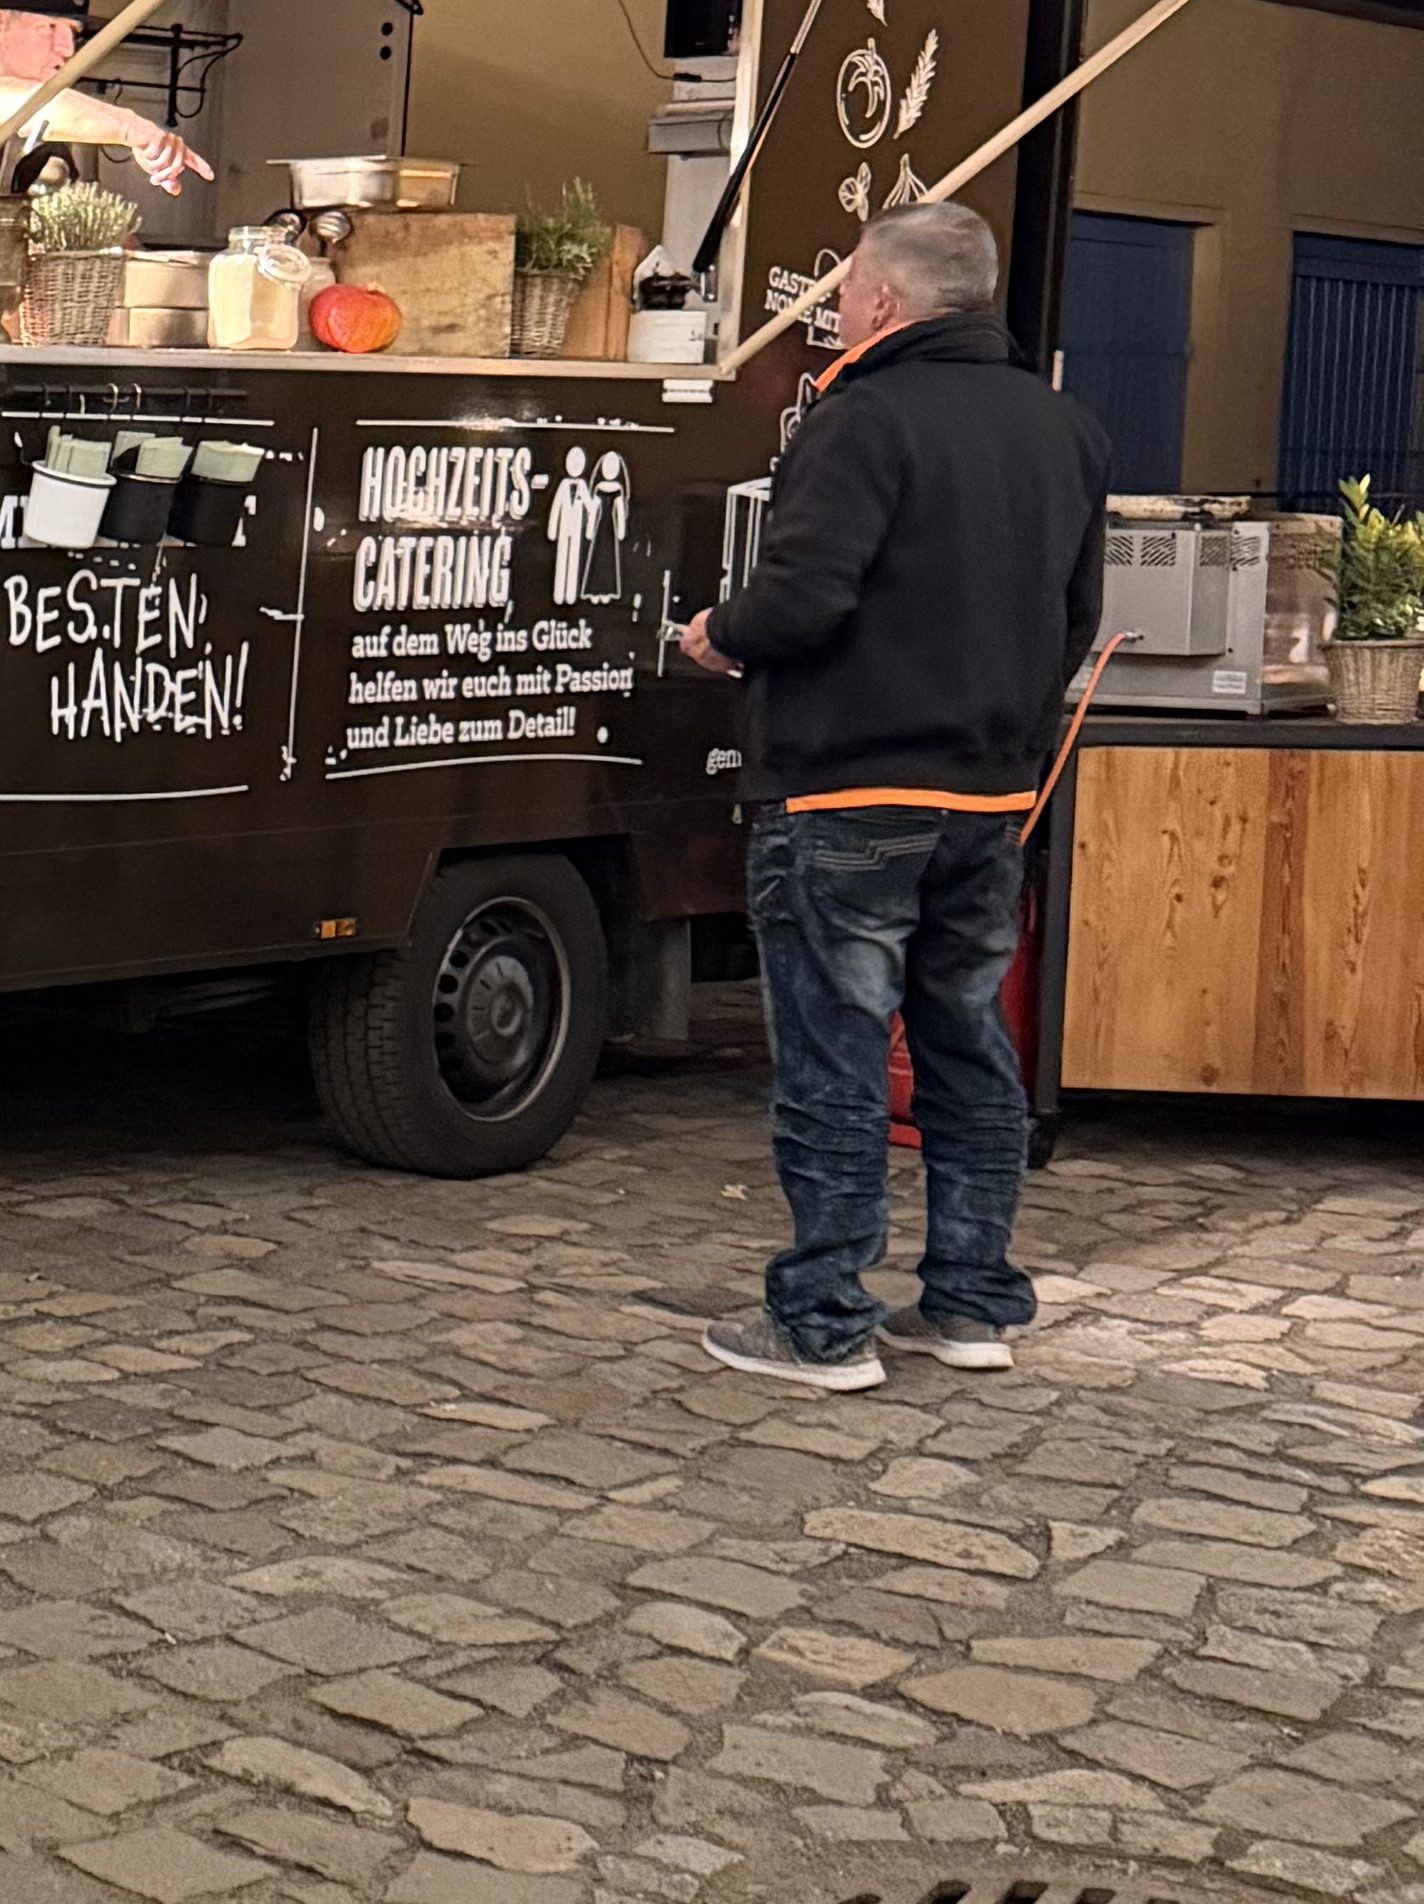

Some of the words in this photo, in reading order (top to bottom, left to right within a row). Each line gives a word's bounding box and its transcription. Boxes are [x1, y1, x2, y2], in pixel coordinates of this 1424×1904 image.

[359, 446, 550, 523] HOCHZEITS-
[353, 536, 513, 612] CATERING
[4, 569, 196, 658] BESTEN
[351, 625, 391, 658] auf
[392, 625, 440, 656] dem
[444, 623, 492, 662] Weg
[495, 623, 528, 652] ins
[532, 619, 593, 651] Glück
[348, 670, 418, 704] helfen
[422, 669, 458, 700] wir
[461, 665, 512, 698] euch
[516, 665, 551, 695] mit
[555, 661, 634, 694] Passion
[346, 715, 390, 749] und
[394, 713, 455, 746] Liebe
[458, 718, 503, 743] zum
[507, 706, 577, 740] Detail!
